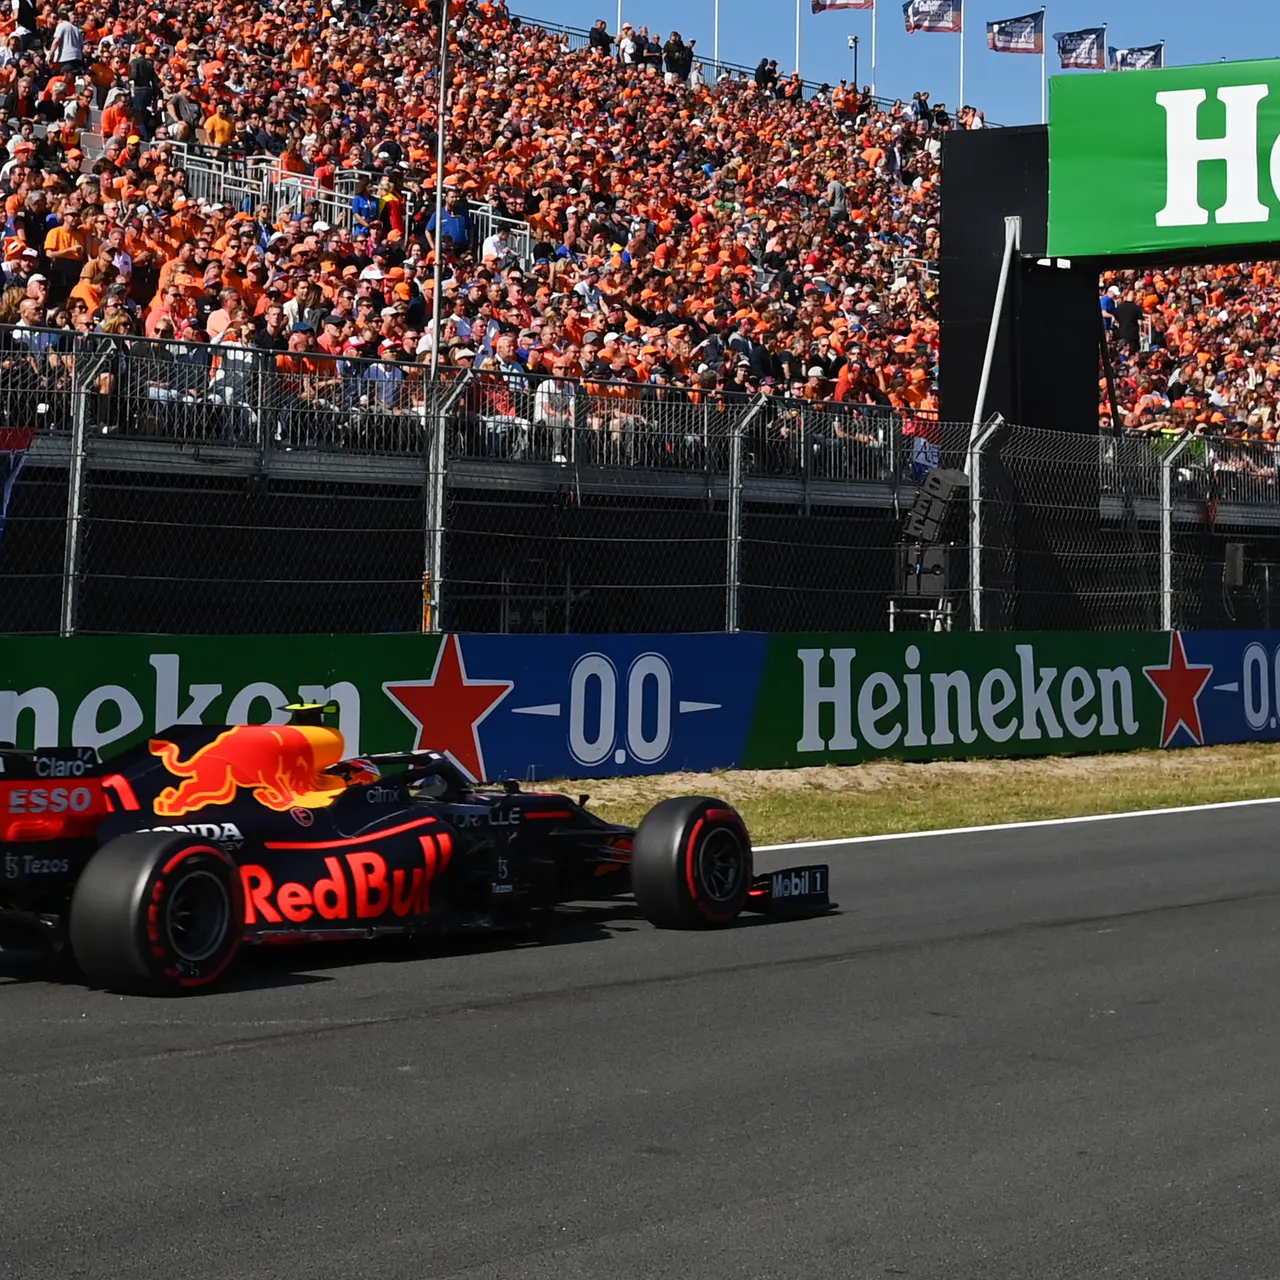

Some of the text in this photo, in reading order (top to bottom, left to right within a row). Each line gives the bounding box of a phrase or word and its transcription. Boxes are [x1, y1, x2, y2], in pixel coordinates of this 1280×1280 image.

[568, 652, 672, 766] 0.0
[797, 644, 1140, 752] Heineken
[36, 757, 85, 777] Claro
[8, 787, 92, 813] ESSO
[23, 855, 69, 874] Tezos
[772, 871, 810, 899] Mobil
